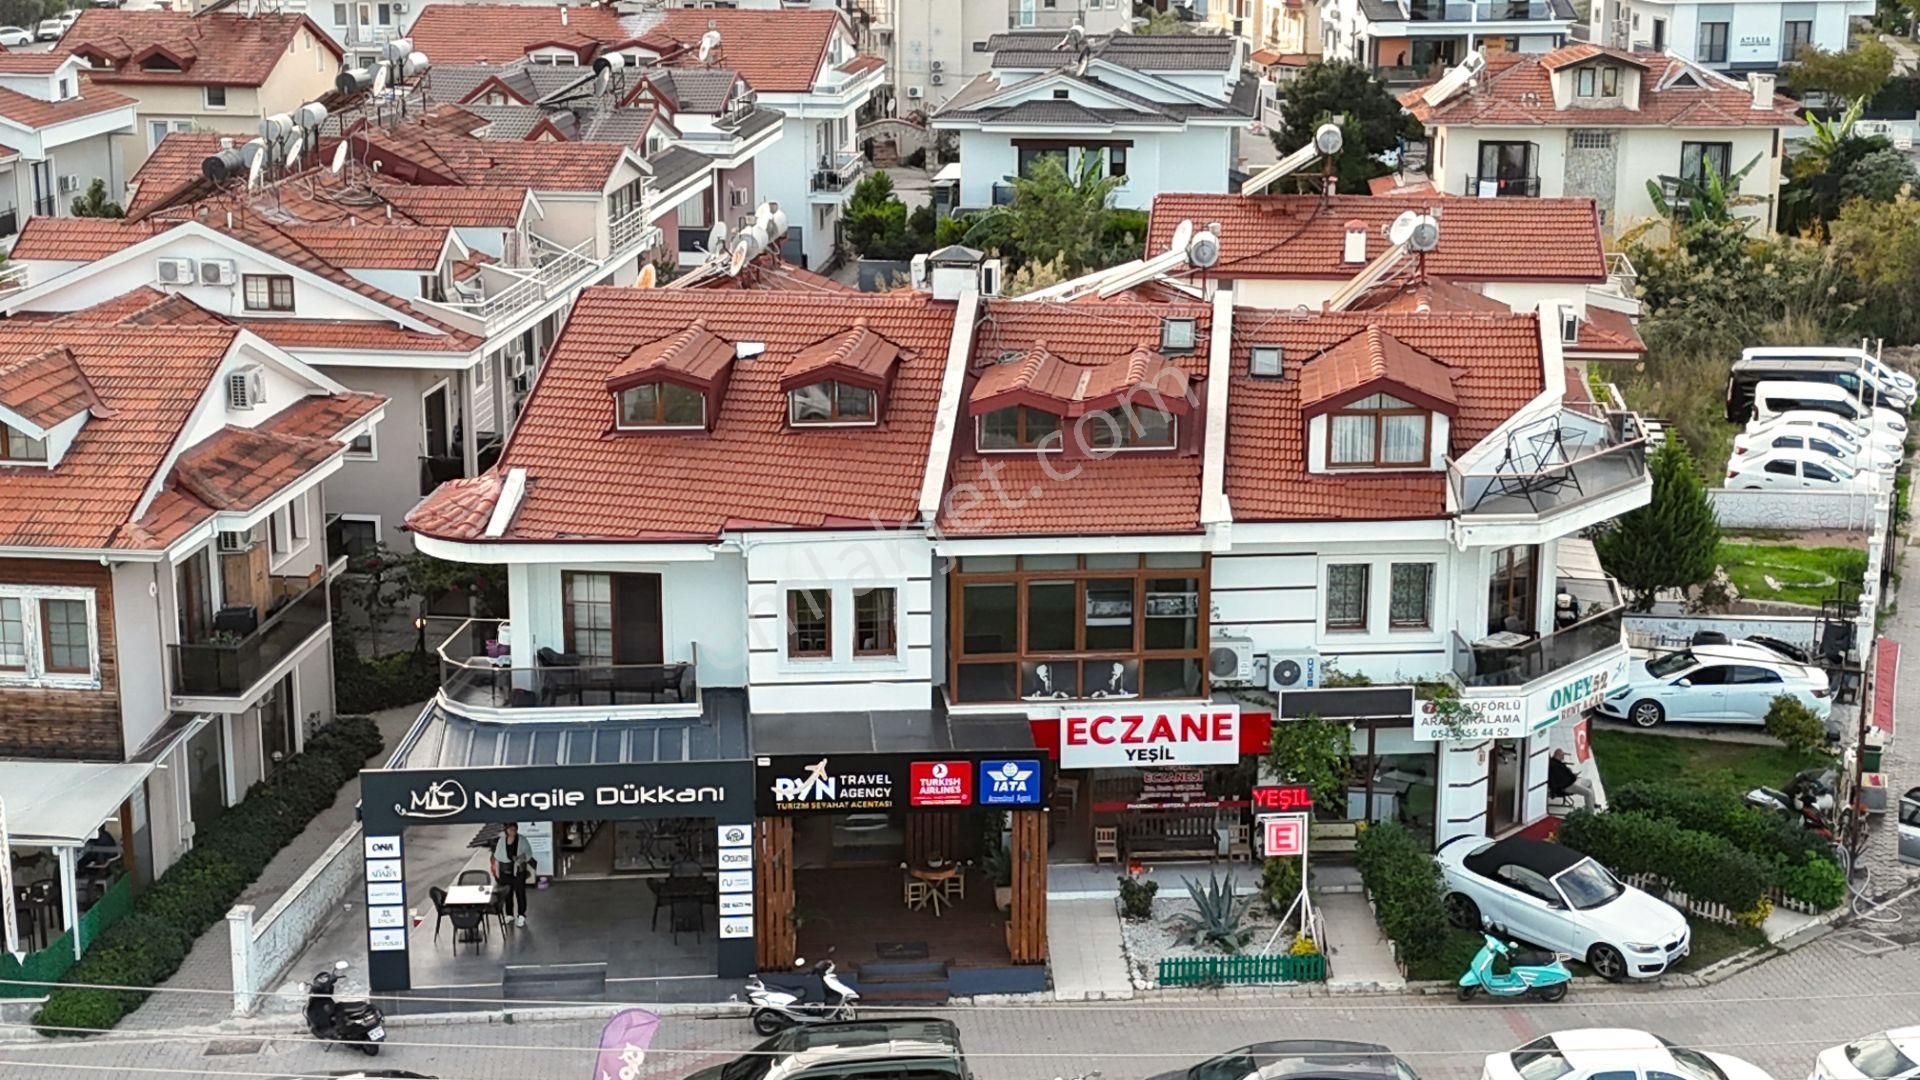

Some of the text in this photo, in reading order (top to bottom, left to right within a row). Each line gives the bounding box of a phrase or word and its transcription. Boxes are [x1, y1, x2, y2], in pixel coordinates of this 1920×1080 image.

[1066, 713, 1233, 746] ECZANE
[1481, 727, 1493, 736] 44
[1497, 727, 1510, 736] 52
[1125, 745, 1175, 763] YEŞİL
[840, 774, 892, 785] TRAVEL
[919, 777, 961, 786] TURKISH
[919, 786, 961, 795] AIRLINES
[993, 781, 1027, 792] IATA
[474, 788, 585, 811] Nargile
[596, 784, 724, 806] Dükkanı
[840, 787, 892, 799] AGENCY
[1276, 827, 1292, 849] E
